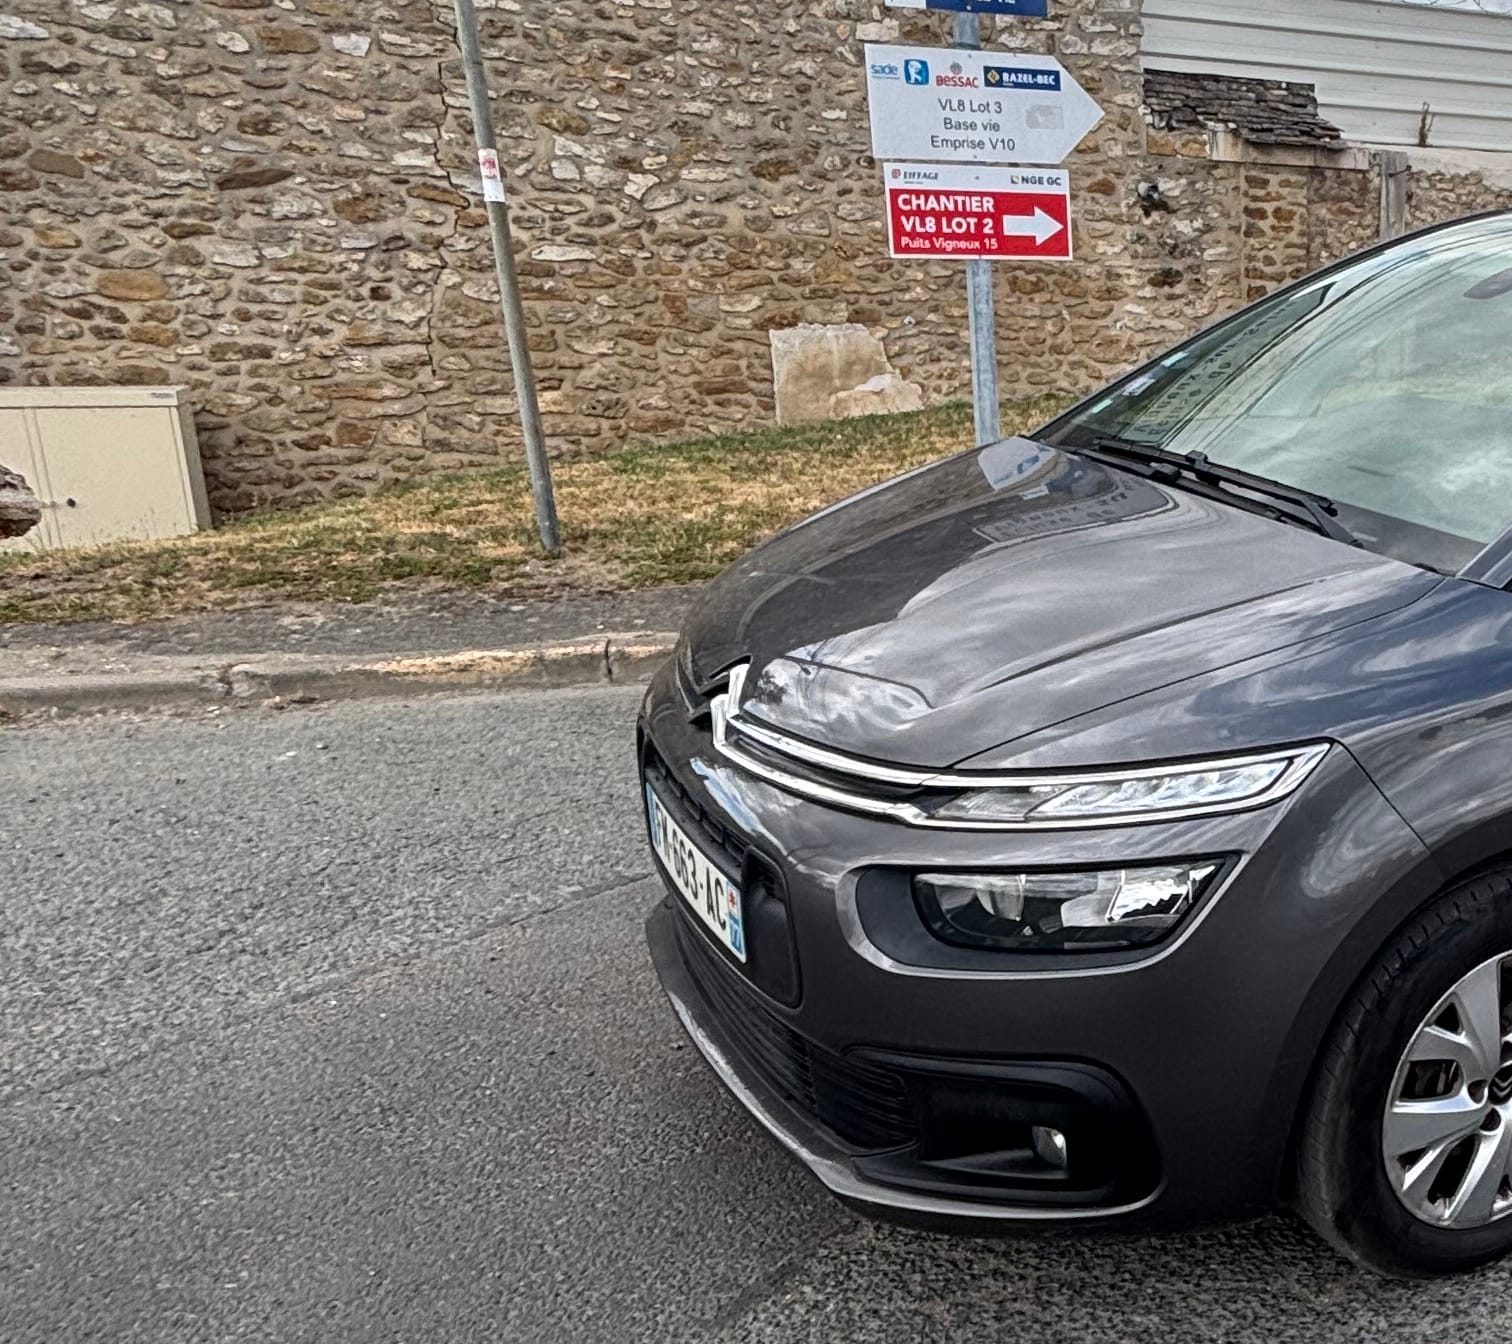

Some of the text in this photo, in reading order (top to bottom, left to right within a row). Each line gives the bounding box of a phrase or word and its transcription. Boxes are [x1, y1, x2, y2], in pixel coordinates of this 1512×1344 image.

[938, 97, 1003, 114] VL8 Lot 3
[943, 117, 1001, 132] Base vie
[931, 135, 1016, 151] Emprise V10
[1021, 175, 1062, 186] NGE GC
[897, 193, 995, 213] CHANTIER
[900, 215, 994, 235] VL8 LOT 2
[900, 236, 998, 252] Puits Vigneux 15
